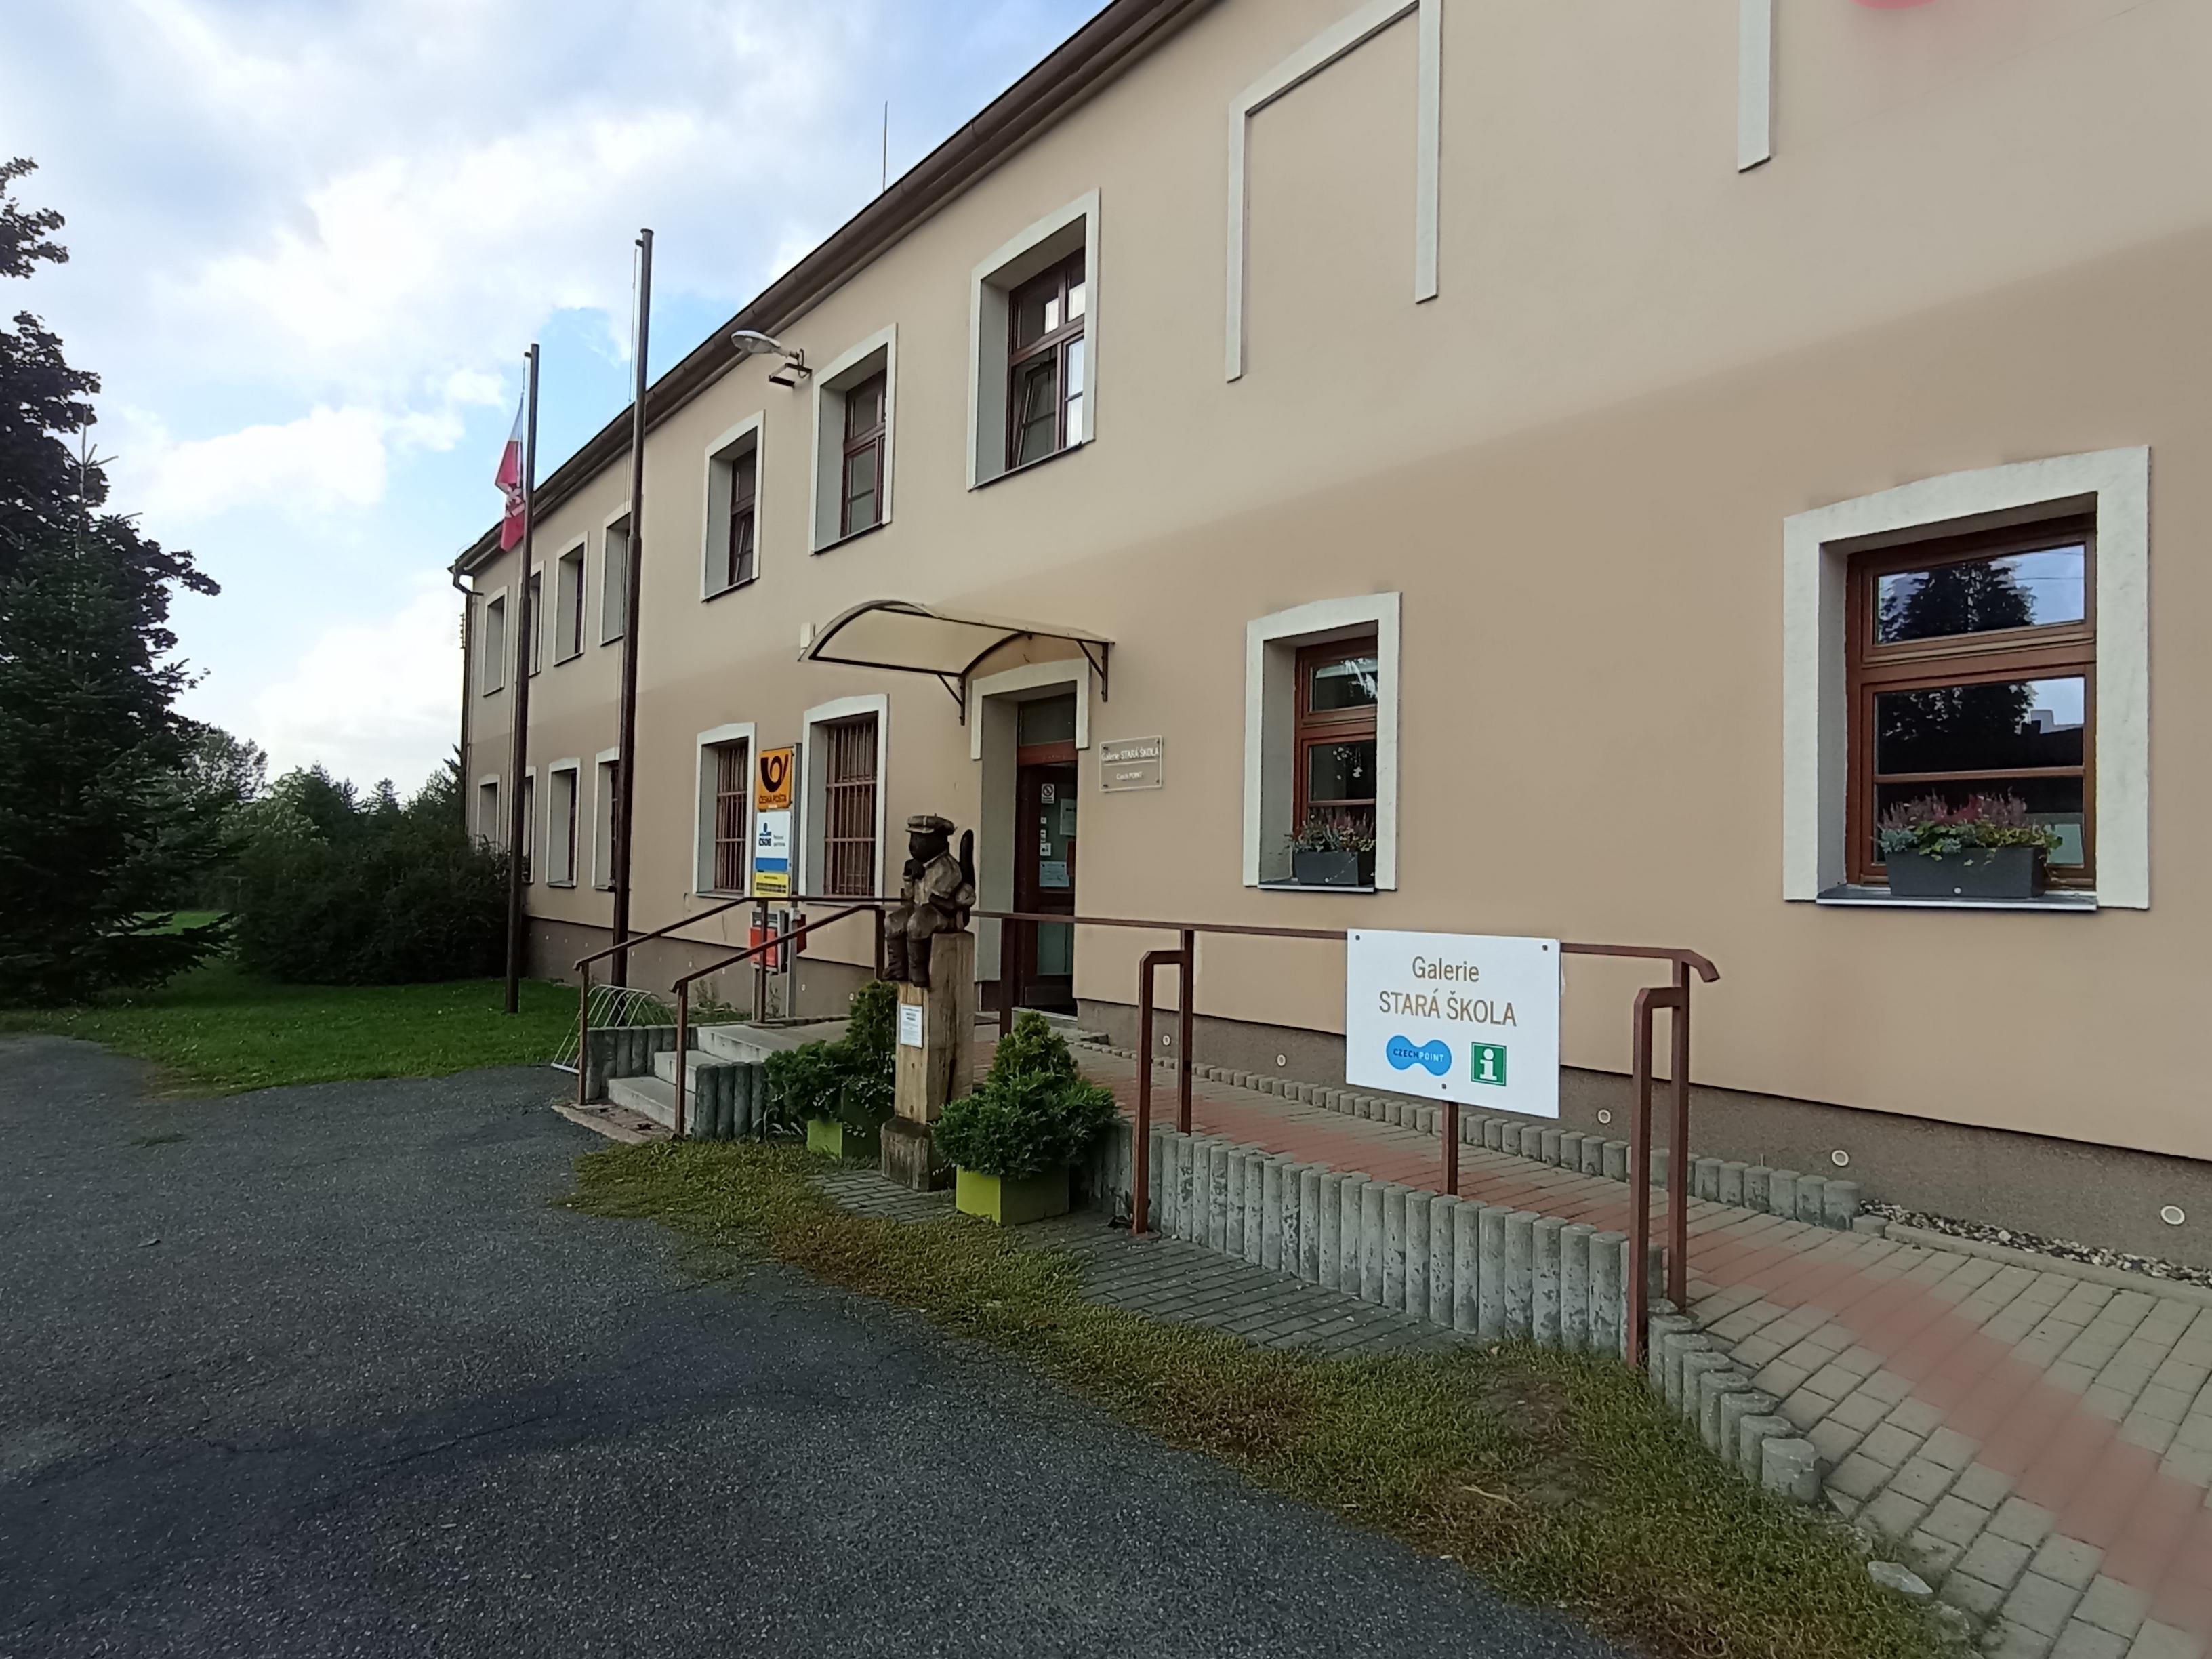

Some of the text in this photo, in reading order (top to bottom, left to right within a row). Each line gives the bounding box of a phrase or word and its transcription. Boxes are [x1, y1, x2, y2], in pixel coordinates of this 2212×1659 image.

[1101, 746, 1159, 762] Galerie STARÁ ŠKOLA
[1412, 956, 1479, 983] Galerie
[1379, 988, 1517, 1027] STARÁ ŠKOLA
